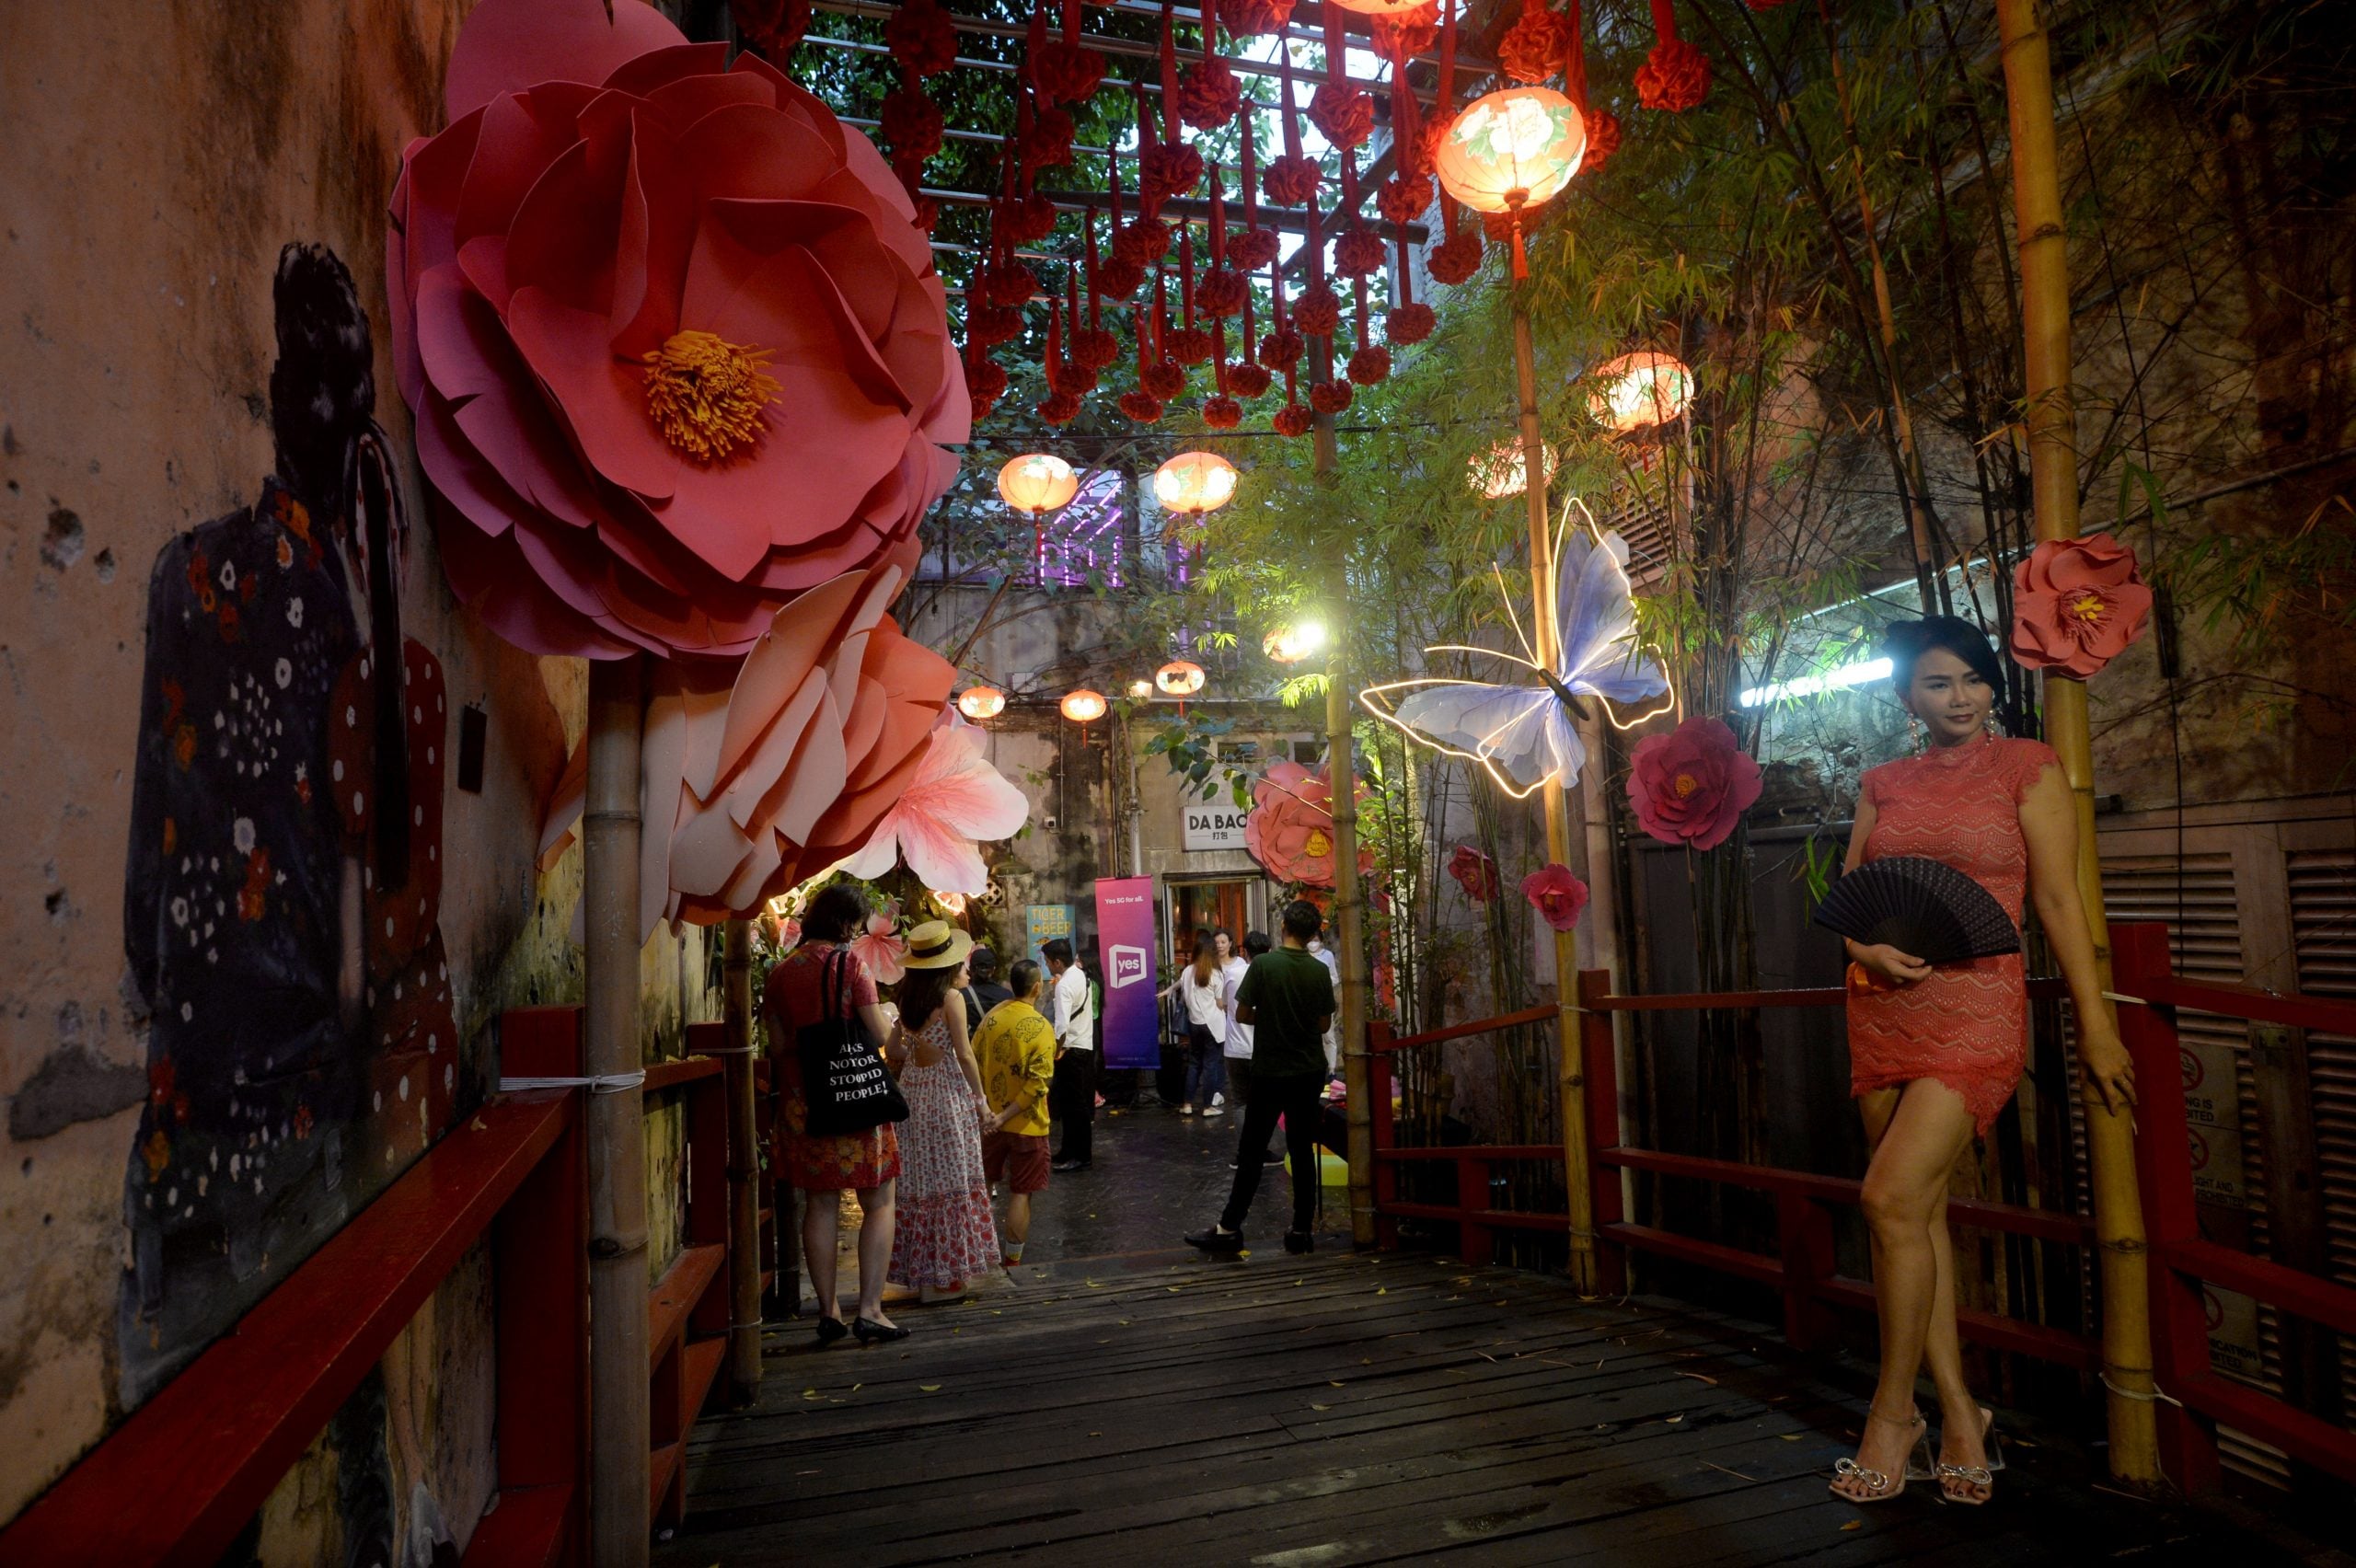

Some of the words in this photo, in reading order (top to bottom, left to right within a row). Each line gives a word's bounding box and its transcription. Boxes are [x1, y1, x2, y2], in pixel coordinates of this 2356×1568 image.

[1189, 815, 1211, 830] DA
[1214, 813, 1247, 829] BAO
[1212, 831, 1229, 840] 打包
[1032, 906, 1065, 921] TIGER
[1042, 921, 1072, 935] BEER
[1117, 959, 1140, 974] yes
[829, 1068, 883, 1086] STOOPID
[836, 1080, 889, 1101] PEOPLE!
[2202, 1098, 2213, 1110] IS
